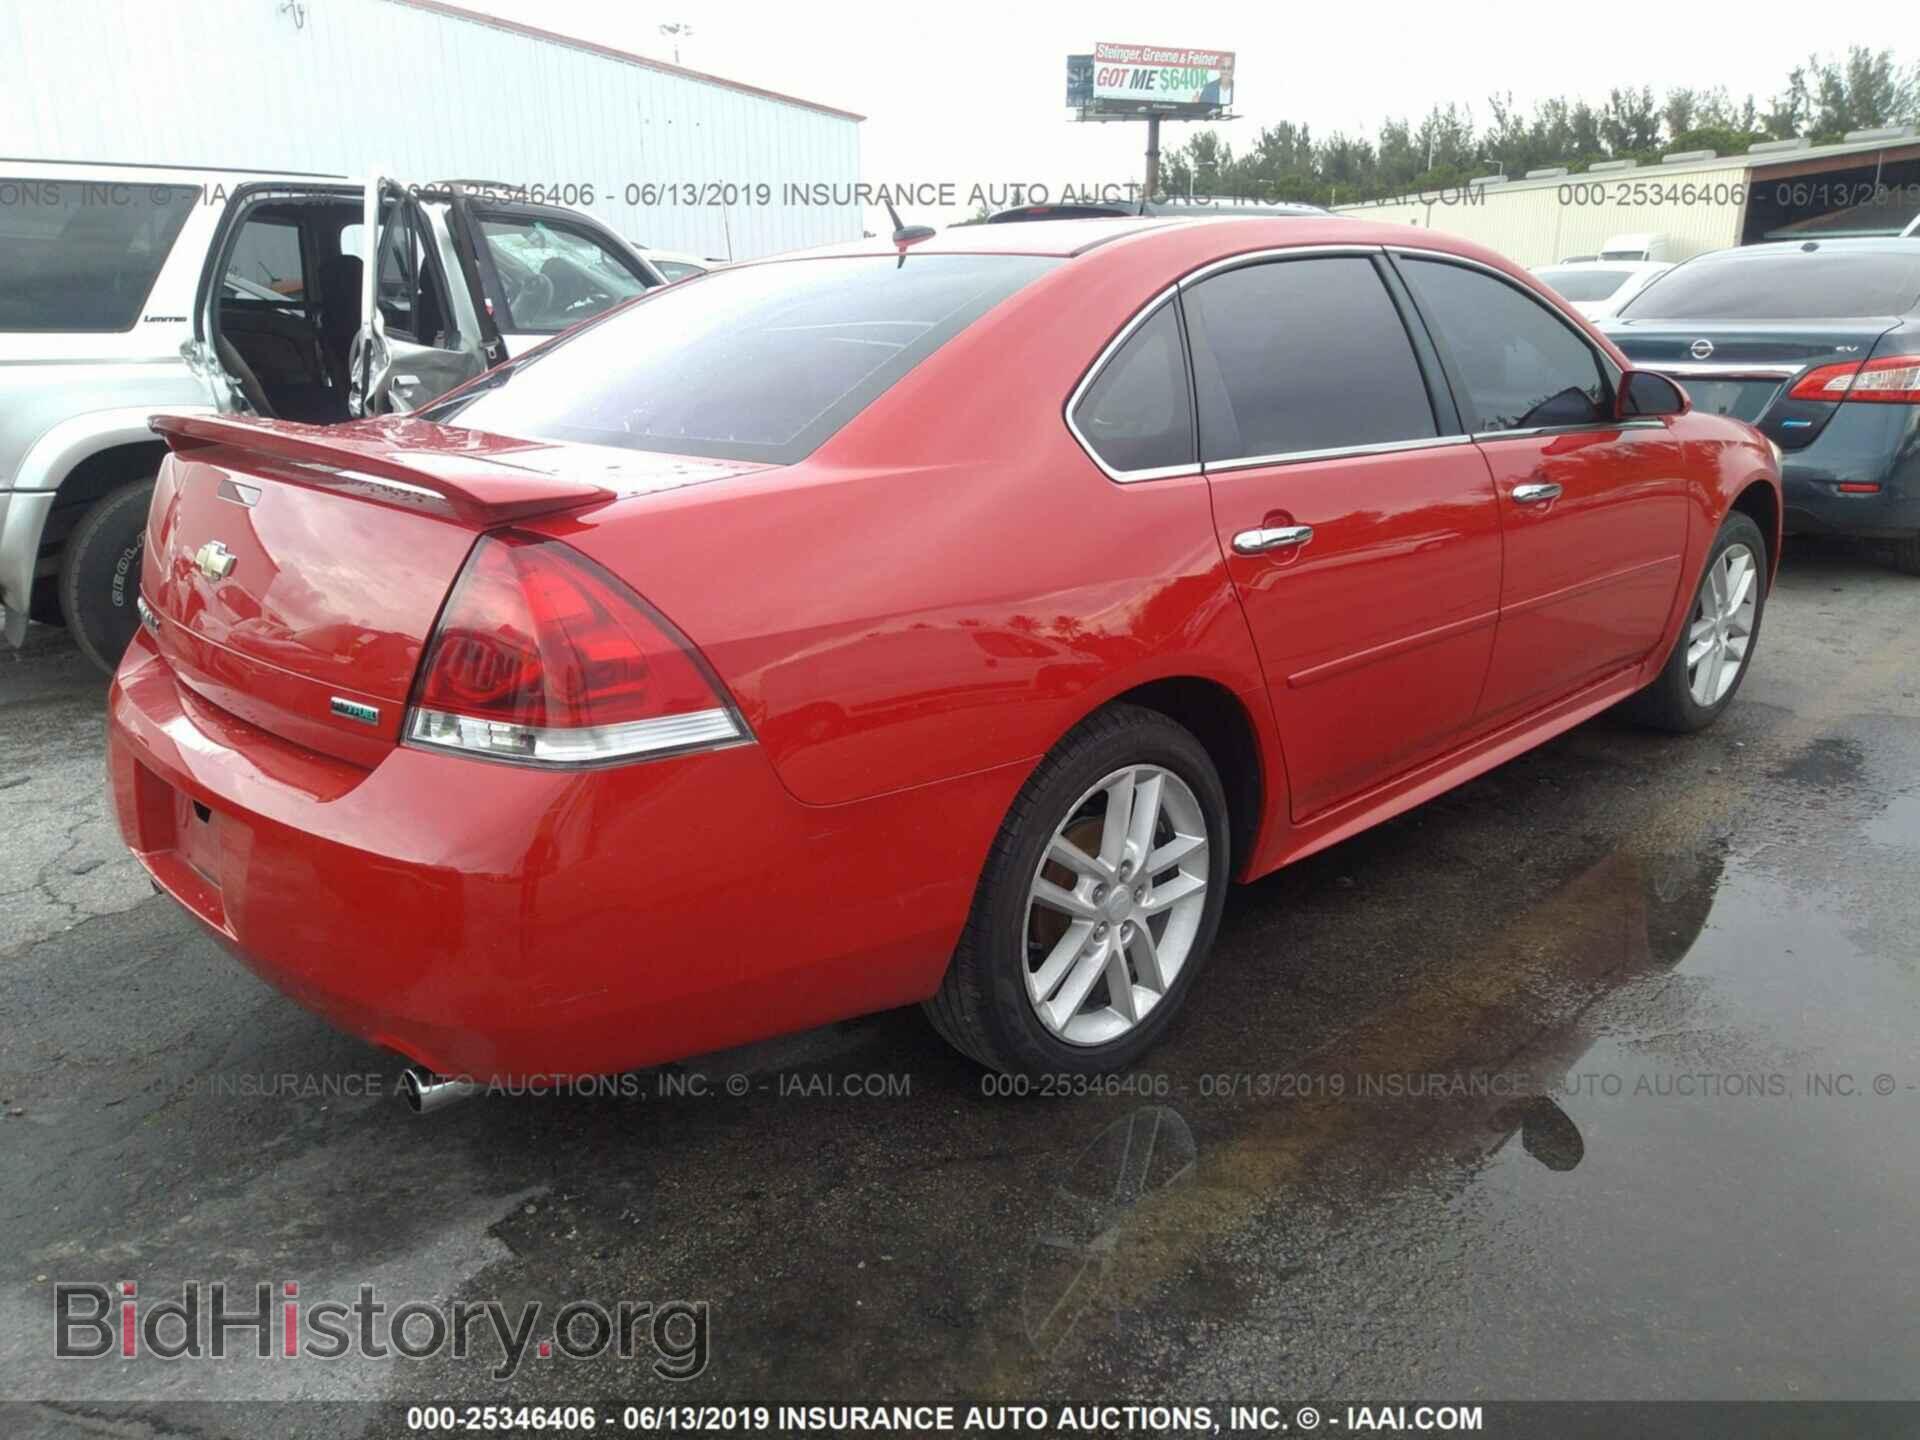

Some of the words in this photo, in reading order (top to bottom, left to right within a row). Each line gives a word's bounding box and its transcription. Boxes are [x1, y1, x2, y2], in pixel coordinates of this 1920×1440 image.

[1143, 47, 1178, 63] Greene
[1097, 67, 1129, 87] GOT
[1129, 69, 1158, 90] ME
[1160, 67, 1209, 93] $640K
